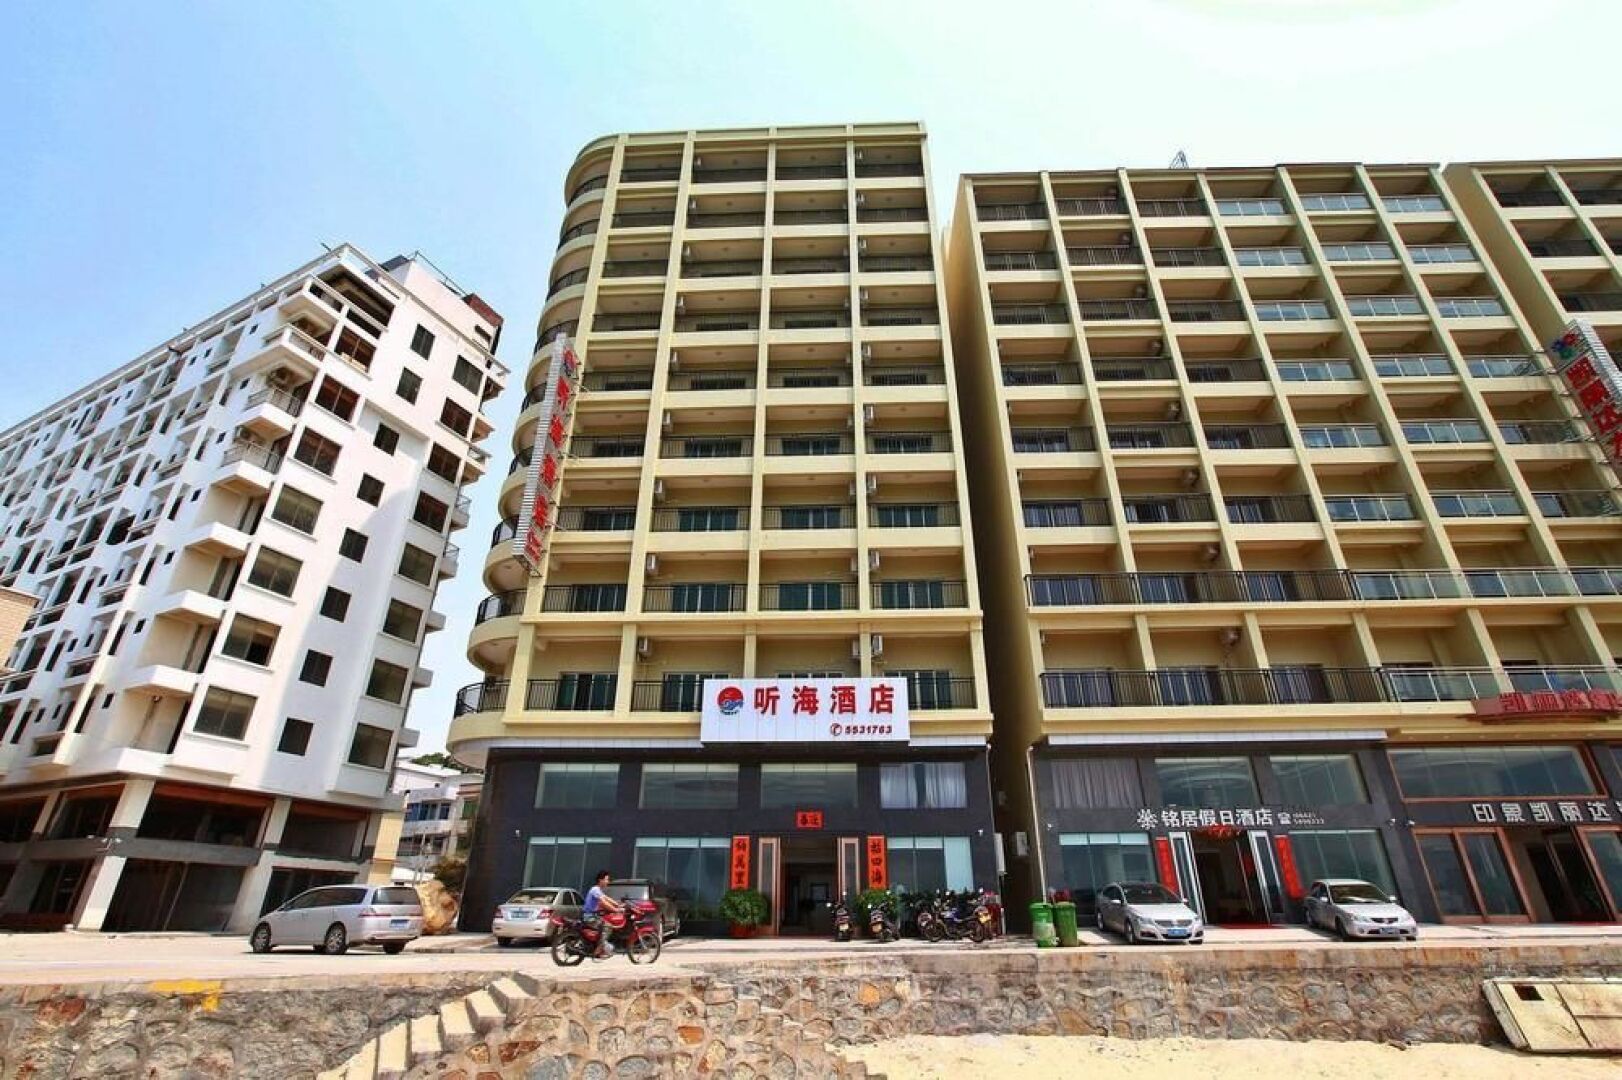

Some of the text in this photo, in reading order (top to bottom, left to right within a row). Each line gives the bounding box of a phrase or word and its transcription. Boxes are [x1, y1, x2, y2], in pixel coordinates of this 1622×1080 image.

[753, 683, 895, 716] 听海酒店
[844, 724, 893, 735] 5531763
[1160, 808, 1274, 828] 铭居假日酒店
[1471, 801, 1622, 823] 印象凯丽达
